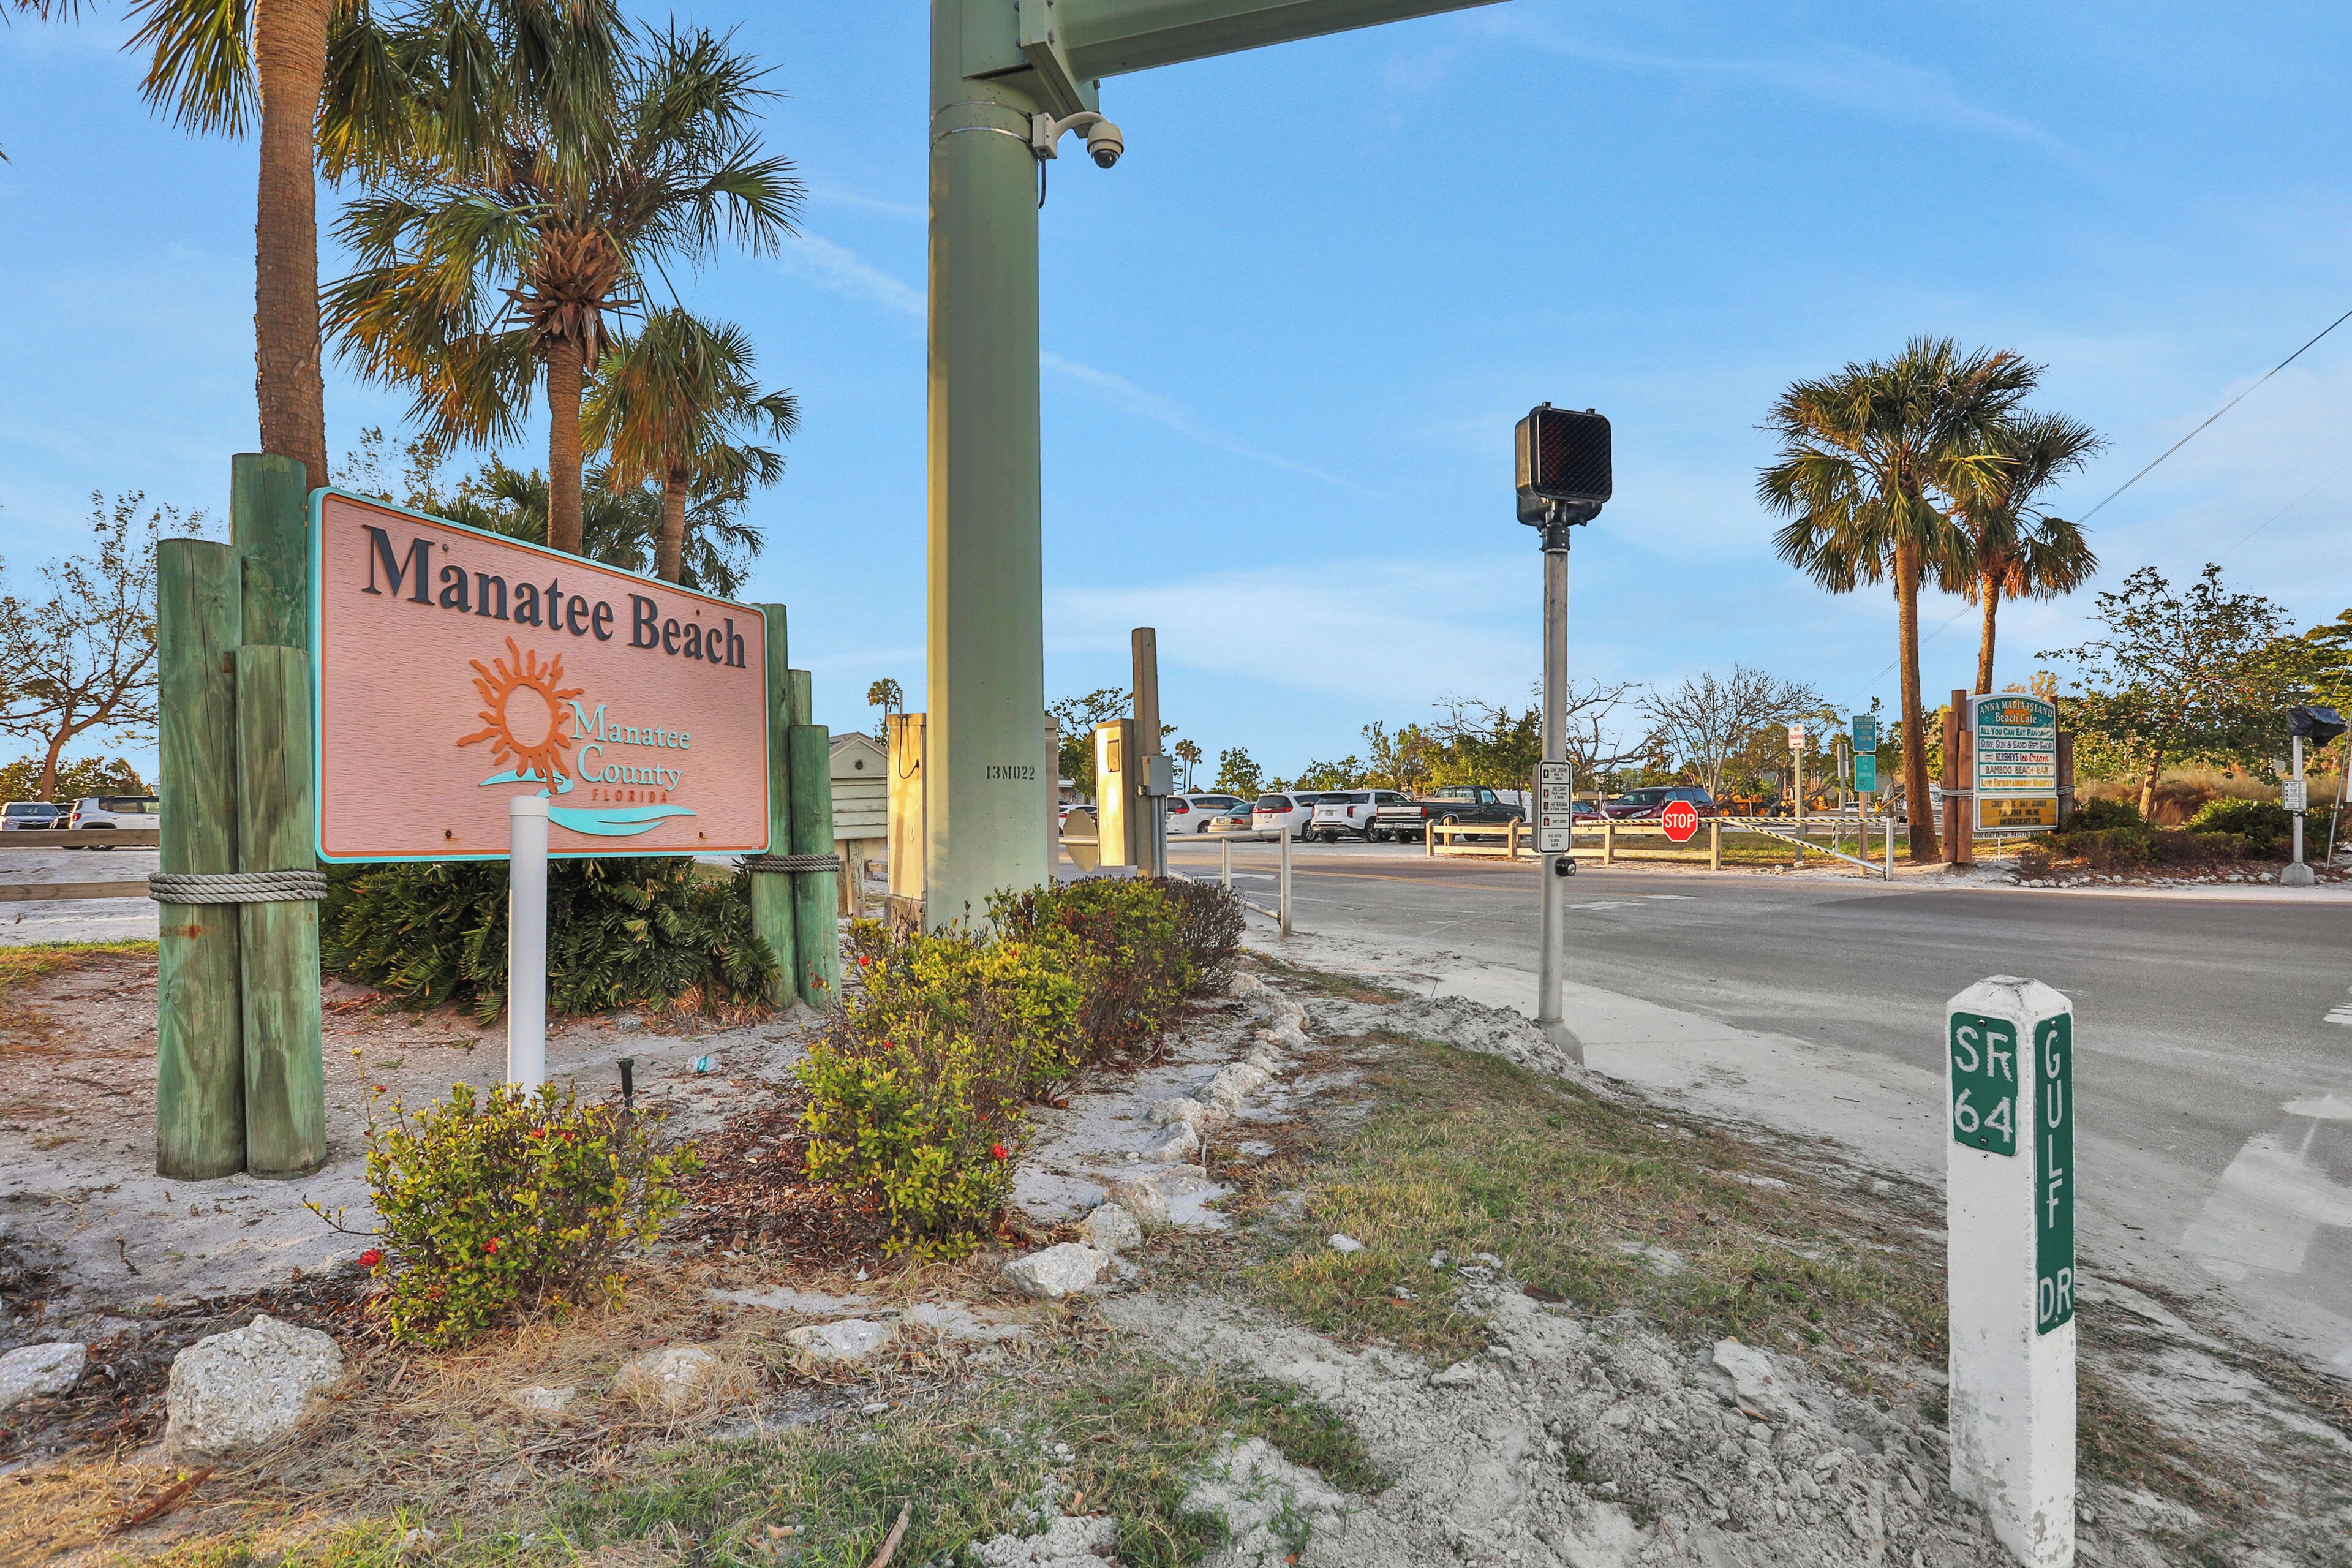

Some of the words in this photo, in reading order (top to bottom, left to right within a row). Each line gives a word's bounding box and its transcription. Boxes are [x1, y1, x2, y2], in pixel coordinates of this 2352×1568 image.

[361, 524, 614, 642] Manatee
[627, 592, 747, 669] Beach
[1980, 702, 2000, 715] ANNA
[2002, 701, 2025, 709] MARIA
[2027, 702, 2052, 718] ISLAND
[1996, 712, 2018, 722] Beach
[2020, 714, 2037, 723] Cafe
[568, 701, 691, 751] Manatee
[2029, 753, 2049, 762] Cream
[2039, 741, 2052, 750] SHOP
[576, 744, 684, 792] County
[1986, 766, 2012, 774] BAMBOO
[592, 788, 668, 804] FLORIDA
[1665, 813, 1695, 828] STOP
[1954, 1025, 2013, 1082] SR
[1954, 1088, 2014, 1143] 64
[2045, 1030, 2063, 1229] GULF
[2040, 1267, 2072, 1325] DR
